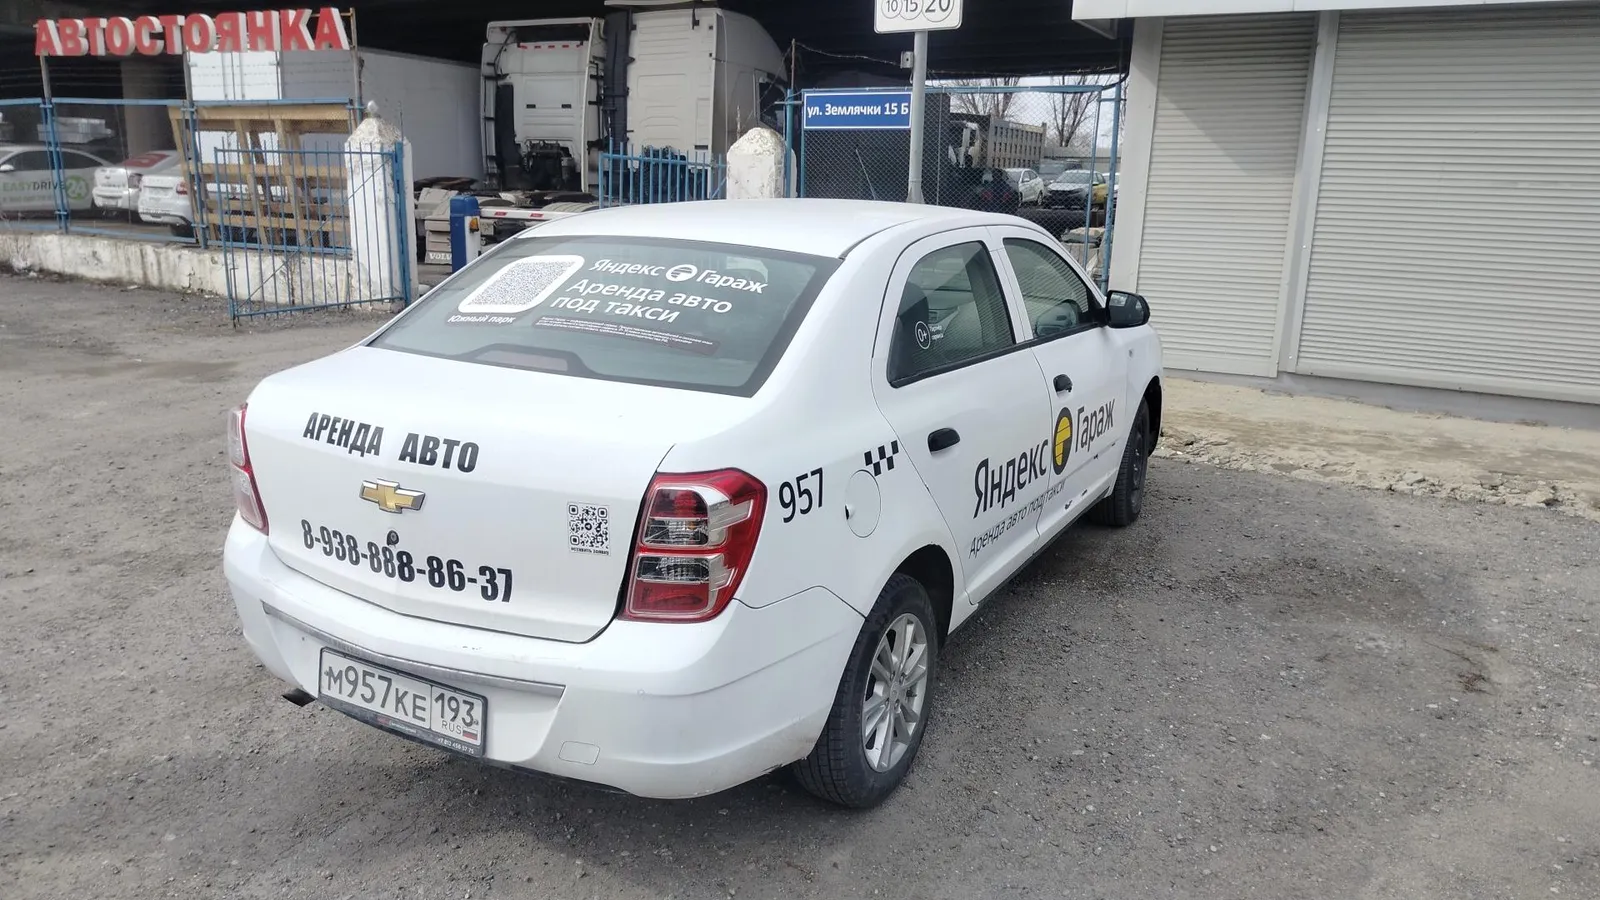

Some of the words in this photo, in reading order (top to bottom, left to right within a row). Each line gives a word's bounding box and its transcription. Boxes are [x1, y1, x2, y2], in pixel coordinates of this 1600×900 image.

[886, 0, 898, 13] 10
[903, 0, 918, 13] 15
[925, 0, 951, 13] 20
[35, 7, 349, 57] АВТОСТОЯНКА
[807, 106, 823, 118] ул.
[824, 103, 881, 116] Землячки
[884, 102, 898, 115] 15
[901, 103, 909, 115] Б
[67, 178, 88, 199] 24
[429, 252, 452, 260] VOLV
[589, 259, 665, 277] Яндекс
[696, 269, 768, 294] Гараж
[550, 296, 601, 314] под
[604, 301, 680, 323] такси
[565, 278, 666, 303] Аренда
[667, 292, 732, 313] авто
[447, 314, 489, 323] Южный
[488, 316, 516, 324] парк
[917, 328, 928, 342] 0+
[302, 411, 385, 457] АРЕНДА
[398, 432, 480, 473] АВТО
[973, 437, 1049, 519] Яндекс
[1074, 398, 1116, 453] Гараж
[778, 467, 824, 523] 957
[968, 521, 1005, 559] Аренда
[1006, 507, 1027, 531] авто
[301, 519, 513, 602] 8-938-888-86-37
[434, 692, 475, 727] 193
[441, 719, 462, 735] RUS
